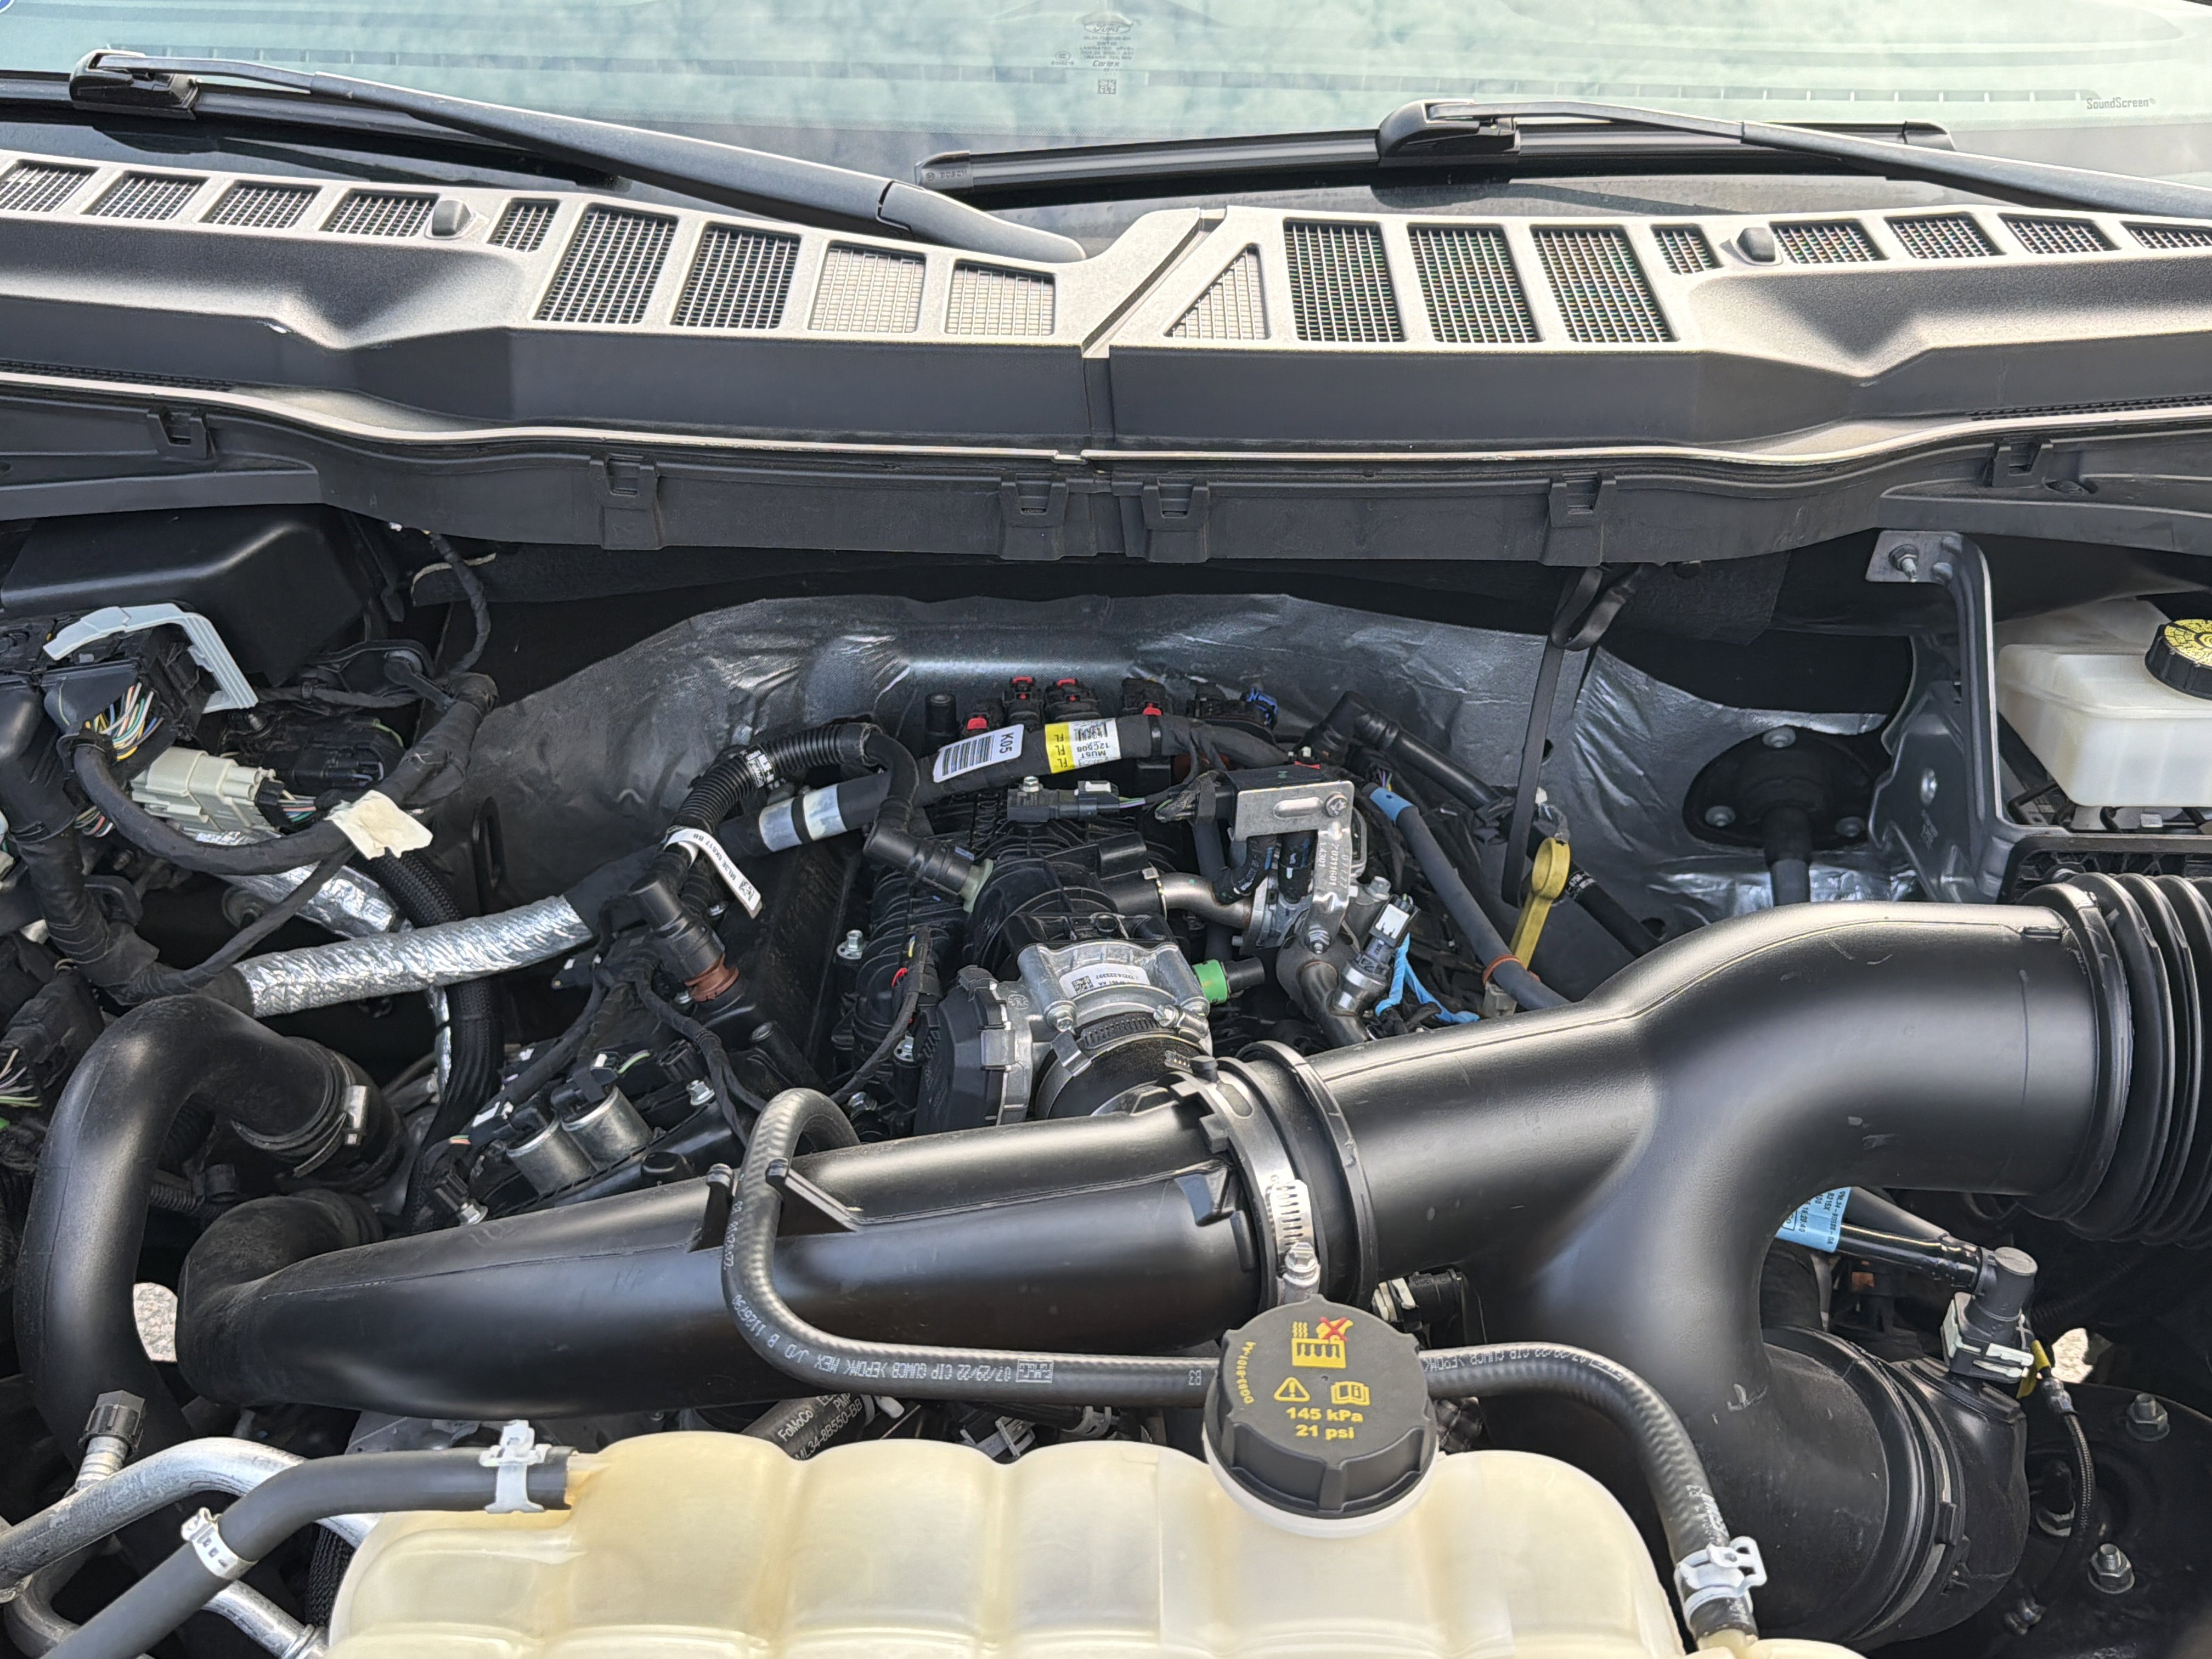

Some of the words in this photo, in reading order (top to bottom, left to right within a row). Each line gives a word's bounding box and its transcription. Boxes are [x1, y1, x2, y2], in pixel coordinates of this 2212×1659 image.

[1000, 732, 1013, 753] K05
[1054, 733, 1064, 742] FL
[1054, 744, 1065, 756] FL
[1057, 757, 1068, 768] FL
[1286, 1407, 1321, 1420] 145
[1327, 1408, 1363, 1422] kPa
[777, 1407, 814, 1442] FoMoCo
[1295, 1425, 1319, 1437] 21
[1325, 1426, 1355, 1440] psi
